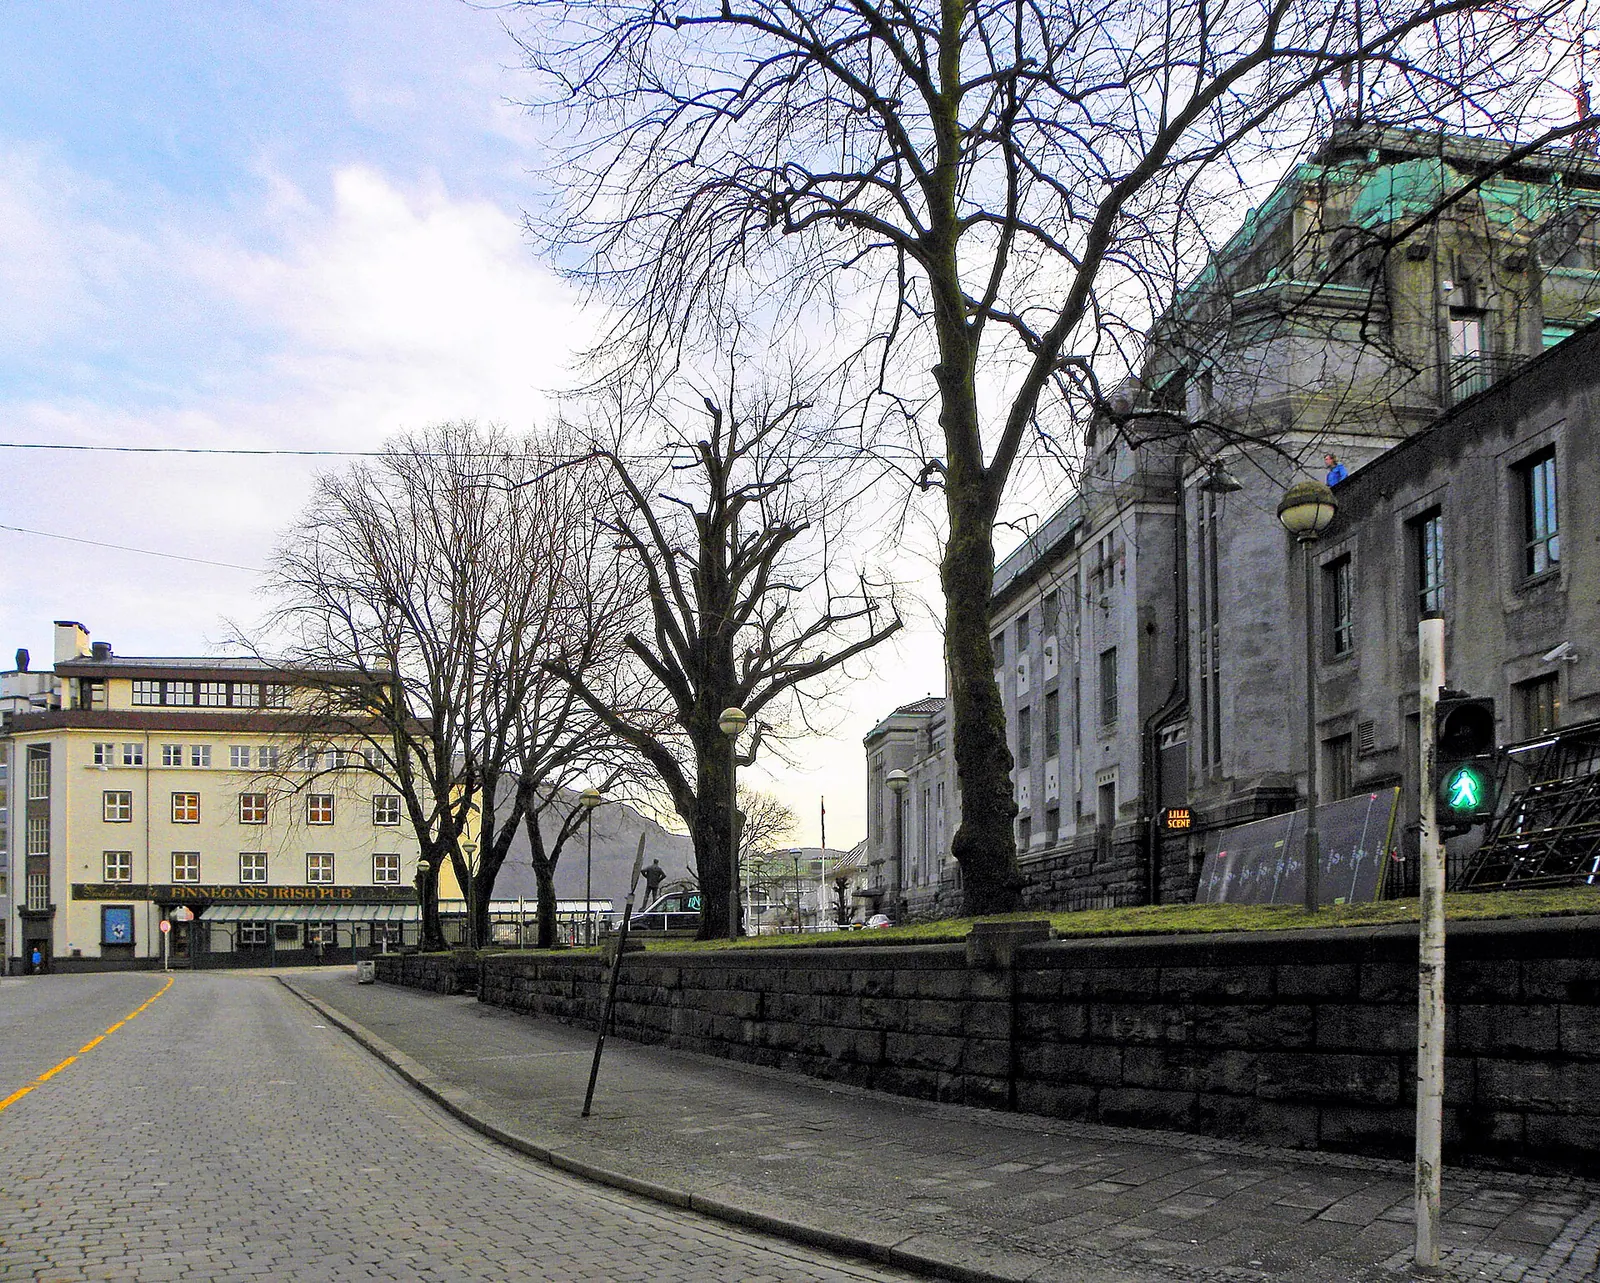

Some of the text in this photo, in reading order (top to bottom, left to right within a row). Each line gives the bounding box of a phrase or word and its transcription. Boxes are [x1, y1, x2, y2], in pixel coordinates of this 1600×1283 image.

[1168, 810, 1190, 819] LILLE
[171, 887, 269, 899] FINNEGAN'S
[273, 888, 316, 899] IRISH
[319, 888, 353, 899] PUB
